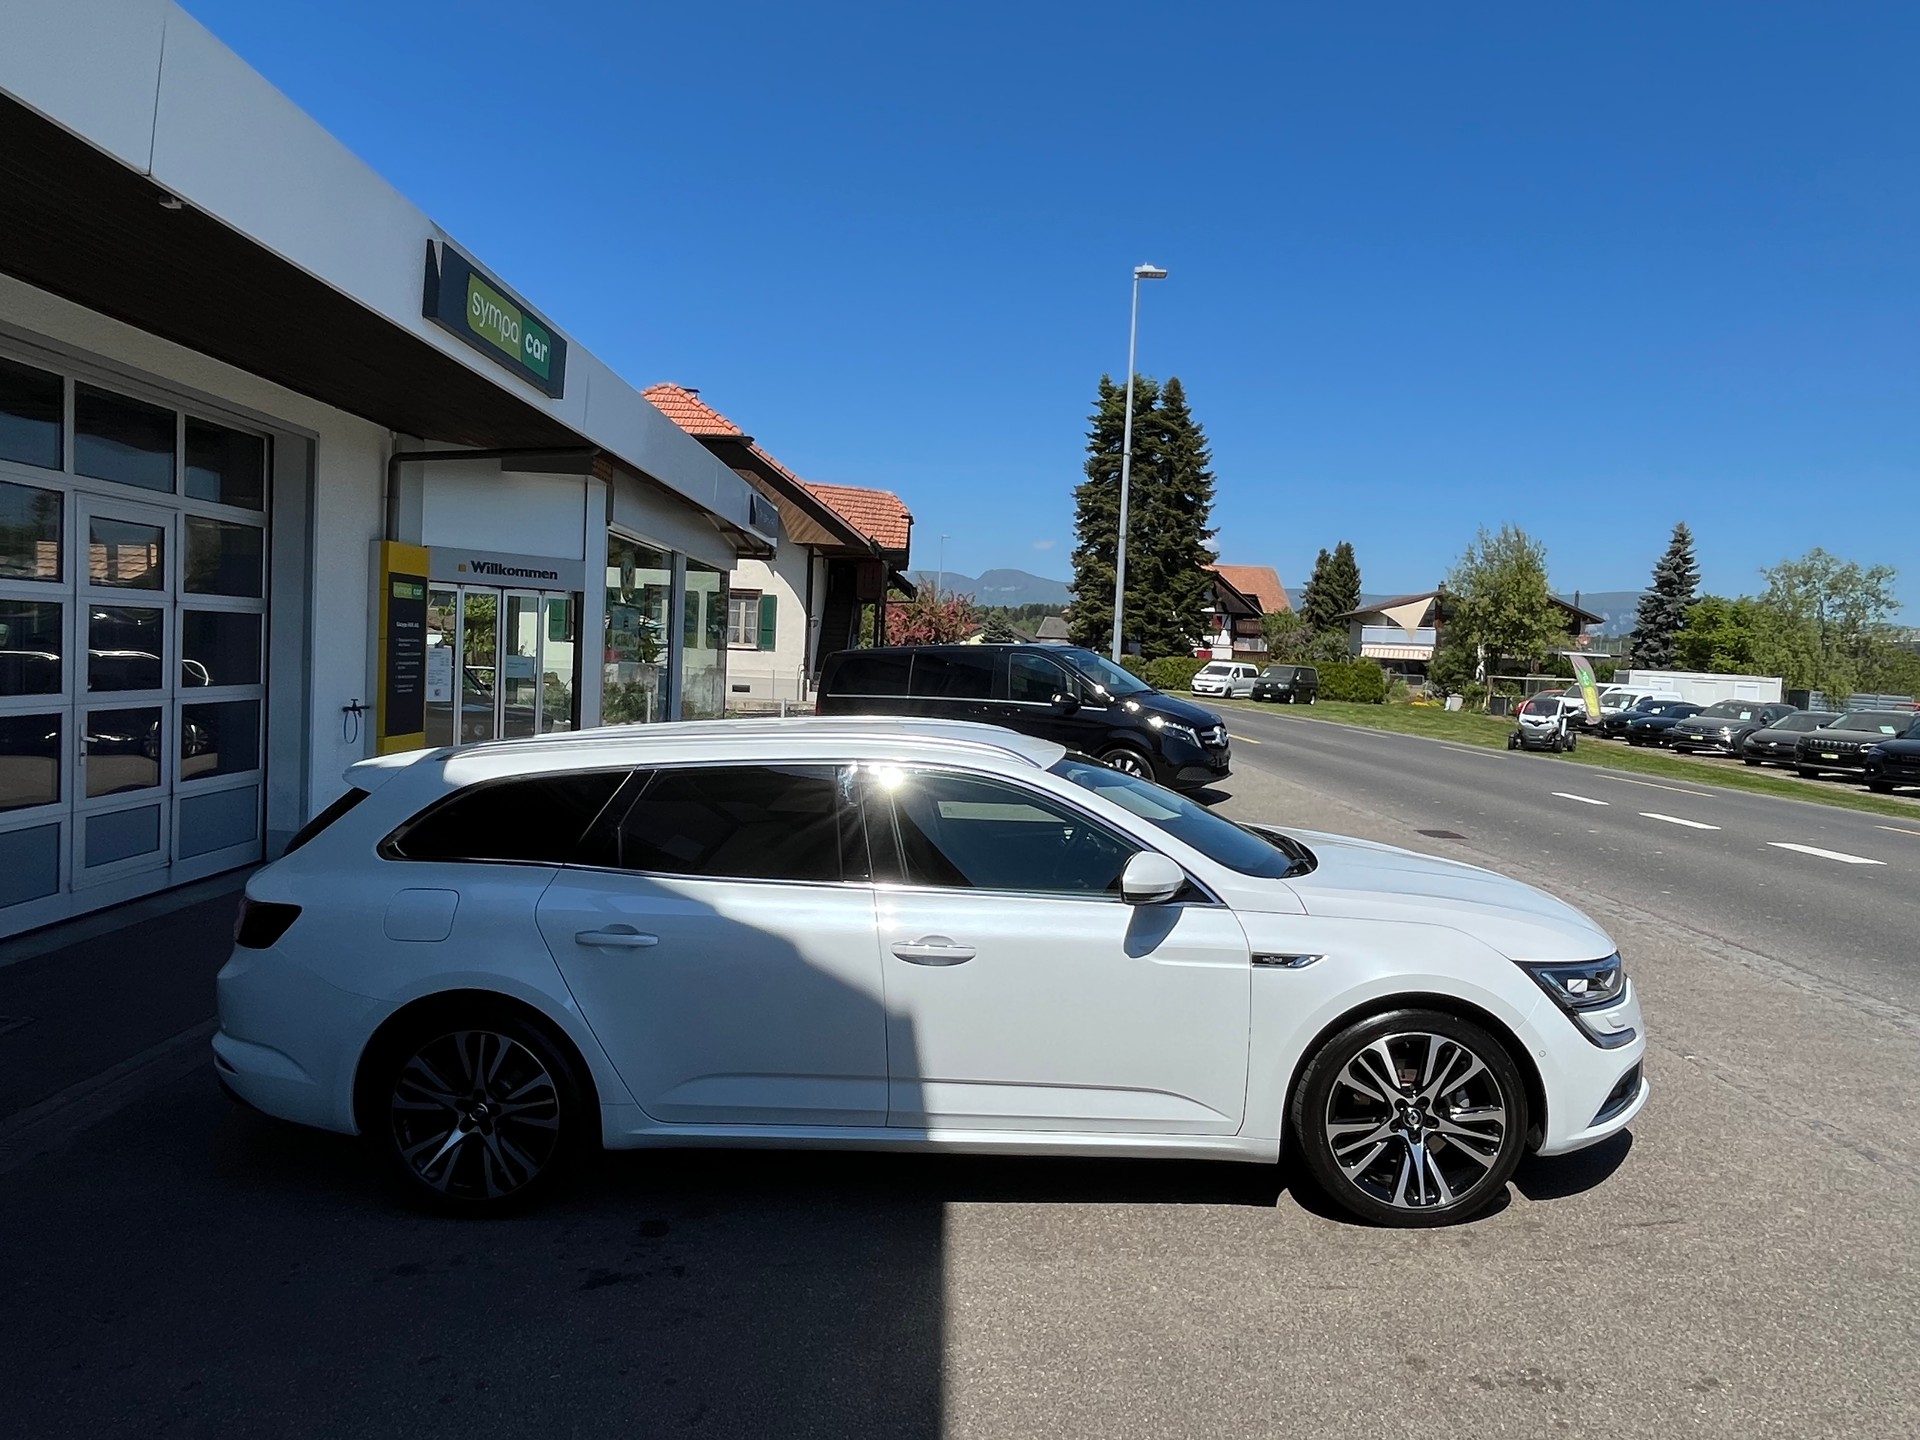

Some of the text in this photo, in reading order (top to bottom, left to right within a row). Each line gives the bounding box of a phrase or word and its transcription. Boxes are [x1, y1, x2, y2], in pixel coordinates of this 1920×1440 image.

[472, 292, 548, 363] sympa car
[471, 560, 558, 580] Willkommen
